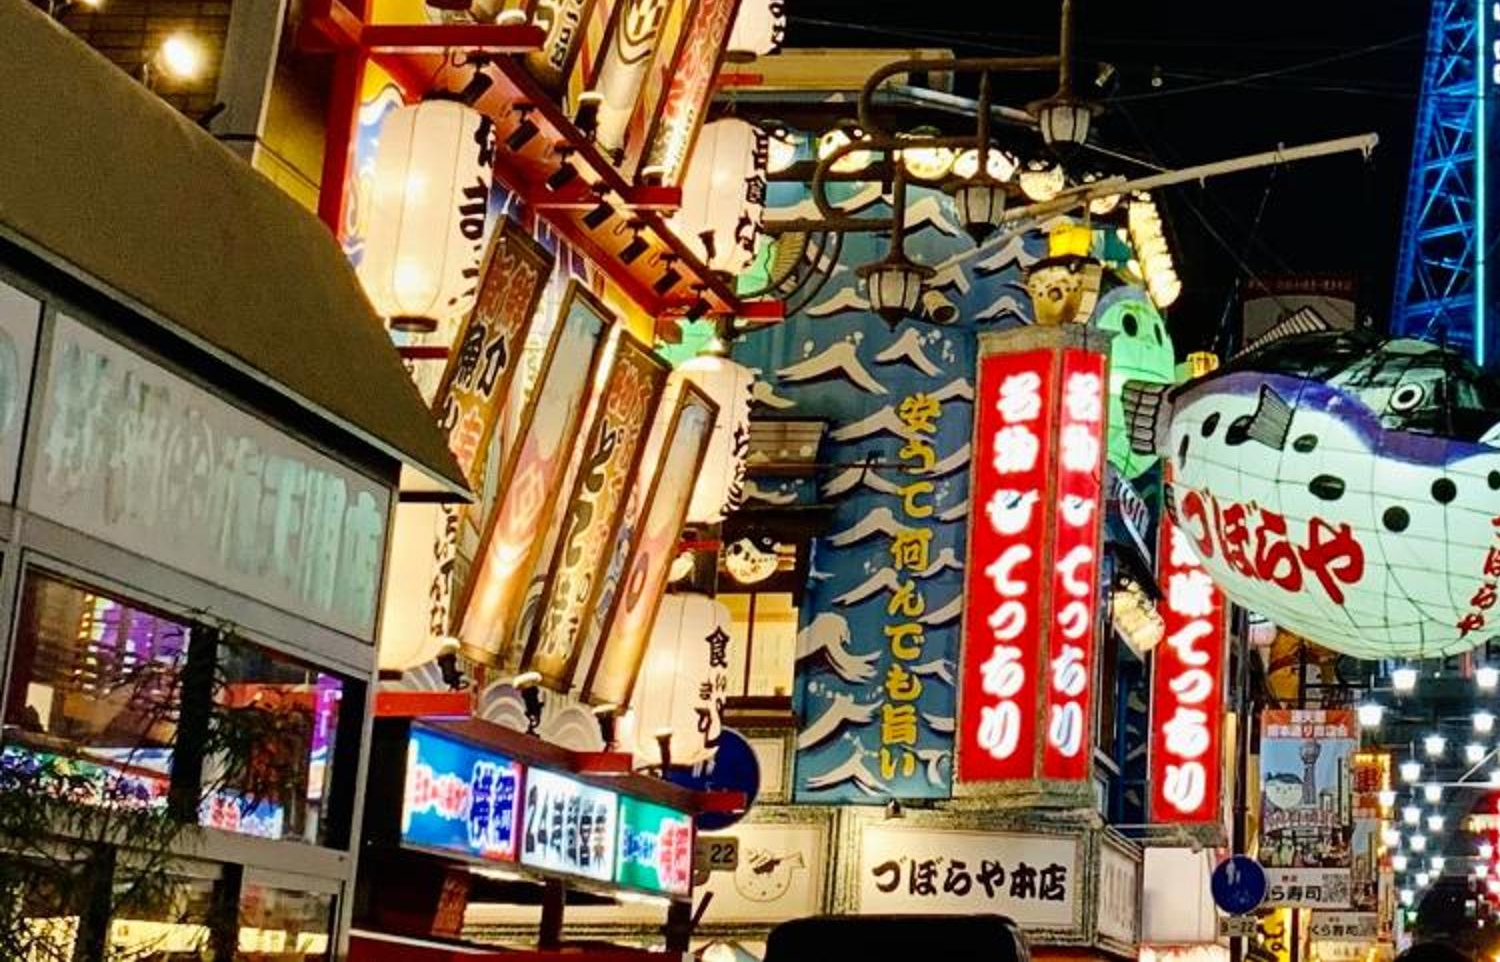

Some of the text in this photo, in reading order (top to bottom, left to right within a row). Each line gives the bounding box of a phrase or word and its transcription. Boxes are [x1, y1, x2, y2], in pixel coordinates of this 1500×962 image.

[880, 393, 942, 781] 安うて何んでも旨い
[977, 542, 1034, 762] てっちり
[1048, 547, 1095, 759] てっちり
[872, 856, 1068, 902] づぼらや本店
[1264, 885, 1321, 901] ら寿司
